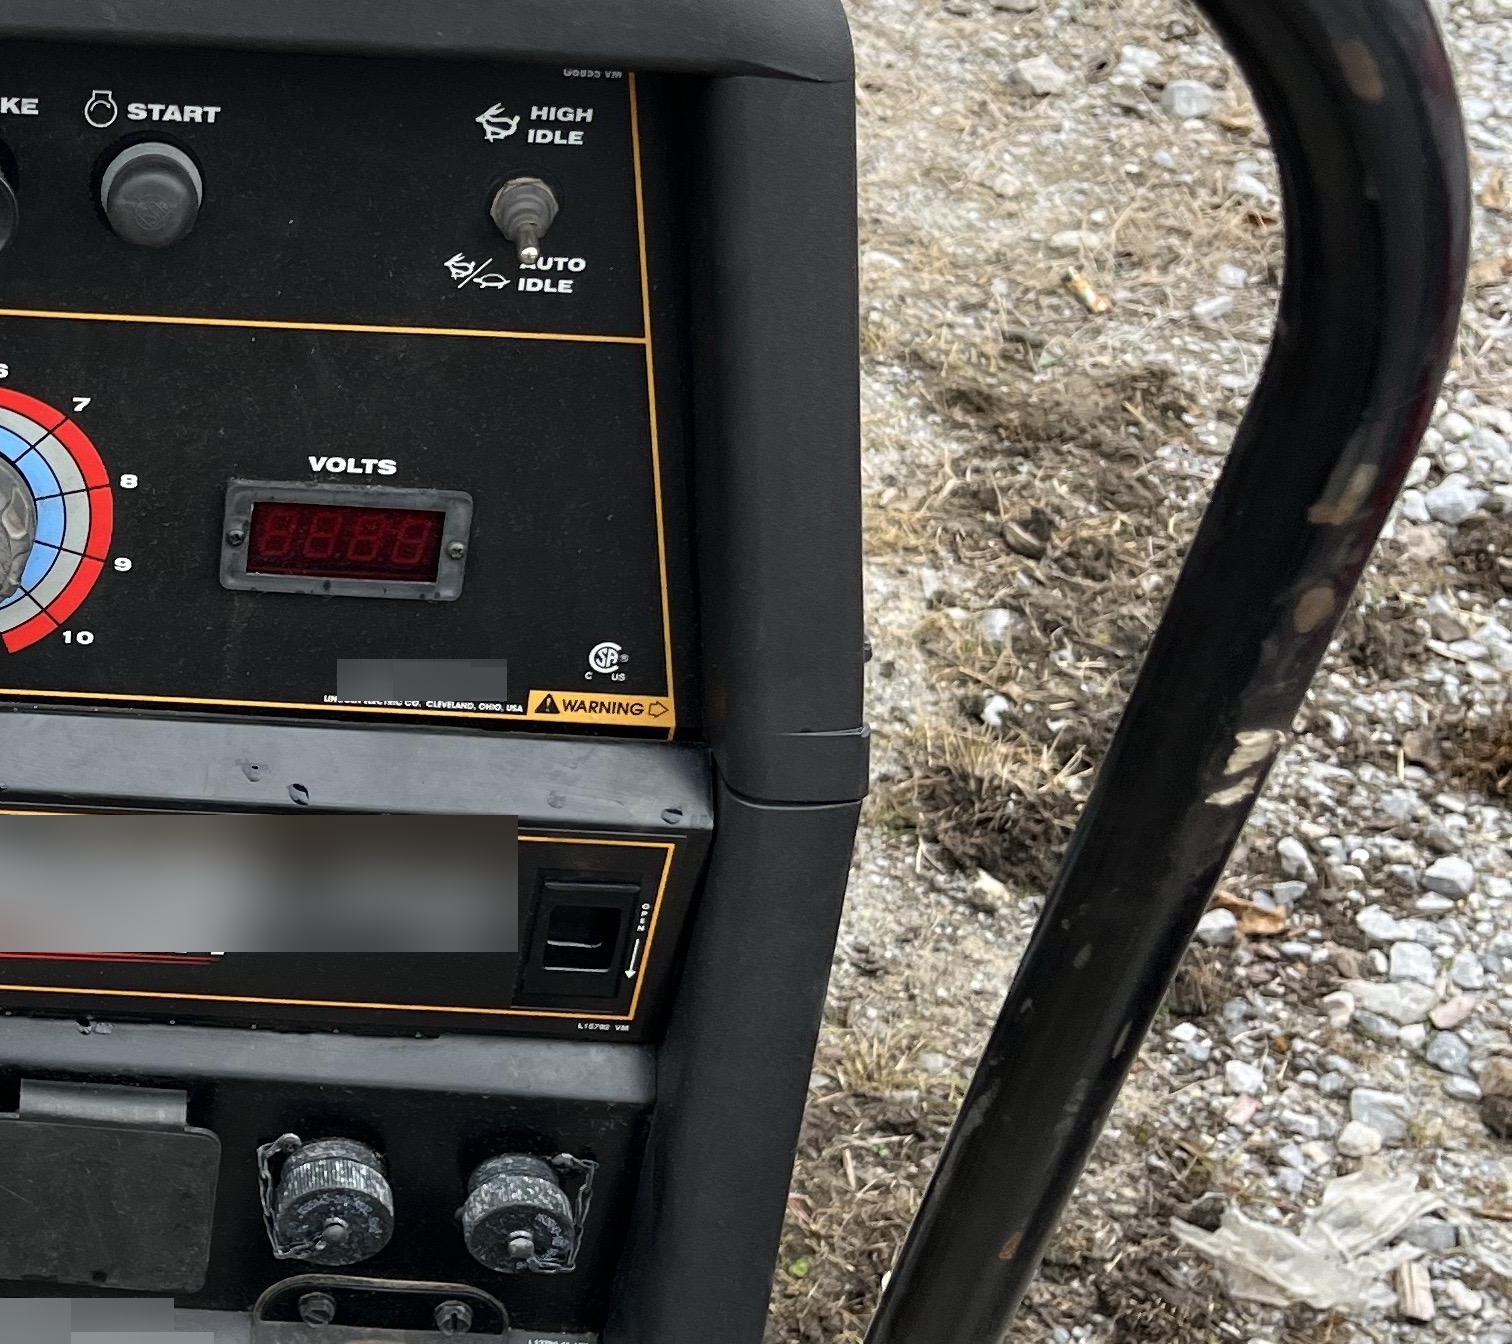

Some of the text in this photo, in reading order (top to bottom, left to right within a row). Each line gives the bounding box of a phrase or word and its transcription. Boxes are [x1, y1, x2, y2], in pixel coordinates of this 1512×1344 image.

[126, 102, 221, 124] START
[530, 106, 594, 123] HIGH
[527, 129, 584, 146] IDLE
[517, 279, 574, 294] IDLE
[72, 397, 91, 413] 7
[308, 455, 398, 475] VOLTS
[119, 474, 138, 489] 8
[113, 557, 133, 573] 9
[61, 629, 95, 645] 10
[611, 673, 626, 681] US
[426, 701, 476, 710] CLEVELAND,
[478, 702, 504, 712] OHIO,
[506, 704, 524, 712] USA
[561, 698, 644, 716] WARNING
[636, 903, 650, 932] OPEN
